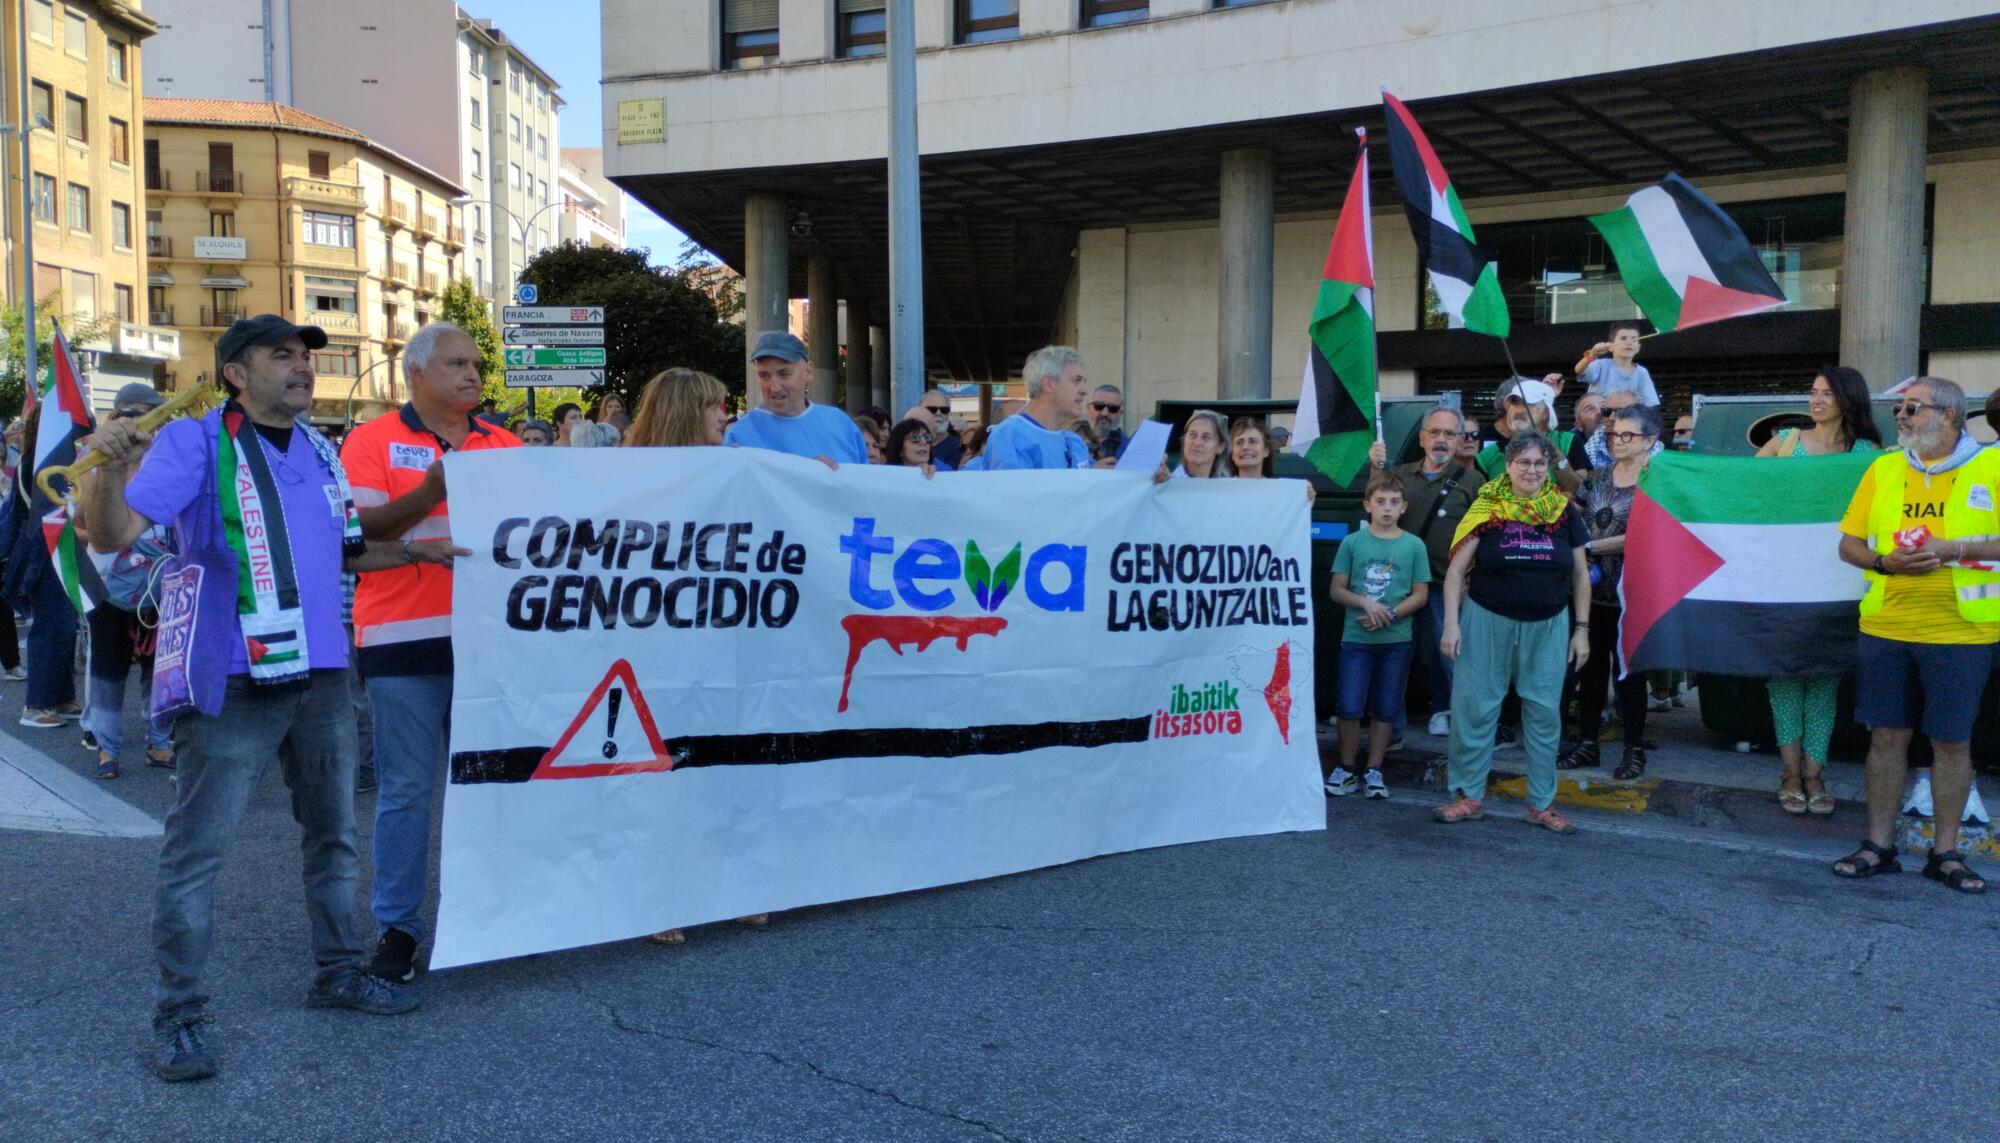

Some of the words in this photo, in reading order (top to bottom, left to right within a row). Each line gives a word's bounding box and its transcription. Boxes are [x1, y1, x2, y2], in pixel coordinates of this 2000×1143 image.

[198, 240, 207, 248] SE
[209, 240, 243, 249] ALQUILA
[505, 311, 545, 319] FRANCIA
[522, 329, 557, 337] Gobierno
[558, 329, 569, 337] de
[571, 329, 603, 337] Navarra
[507, 374, 554, 382] ZARAGOZA
[238, 463, 274, 593] PALESTINE
[492, 515, 753, 574] COMPLICE
[756, 530, 807, 575] de
[839, 517, 1088, 613] teva
[505, 573, 800, 633] GENOCIDIO
[1107, 586, 1309, 633] LAGUNTZAILE
[1170, 680, 1240, 714] ibaitik
[1153, 709, 1242, 740] itsasora
